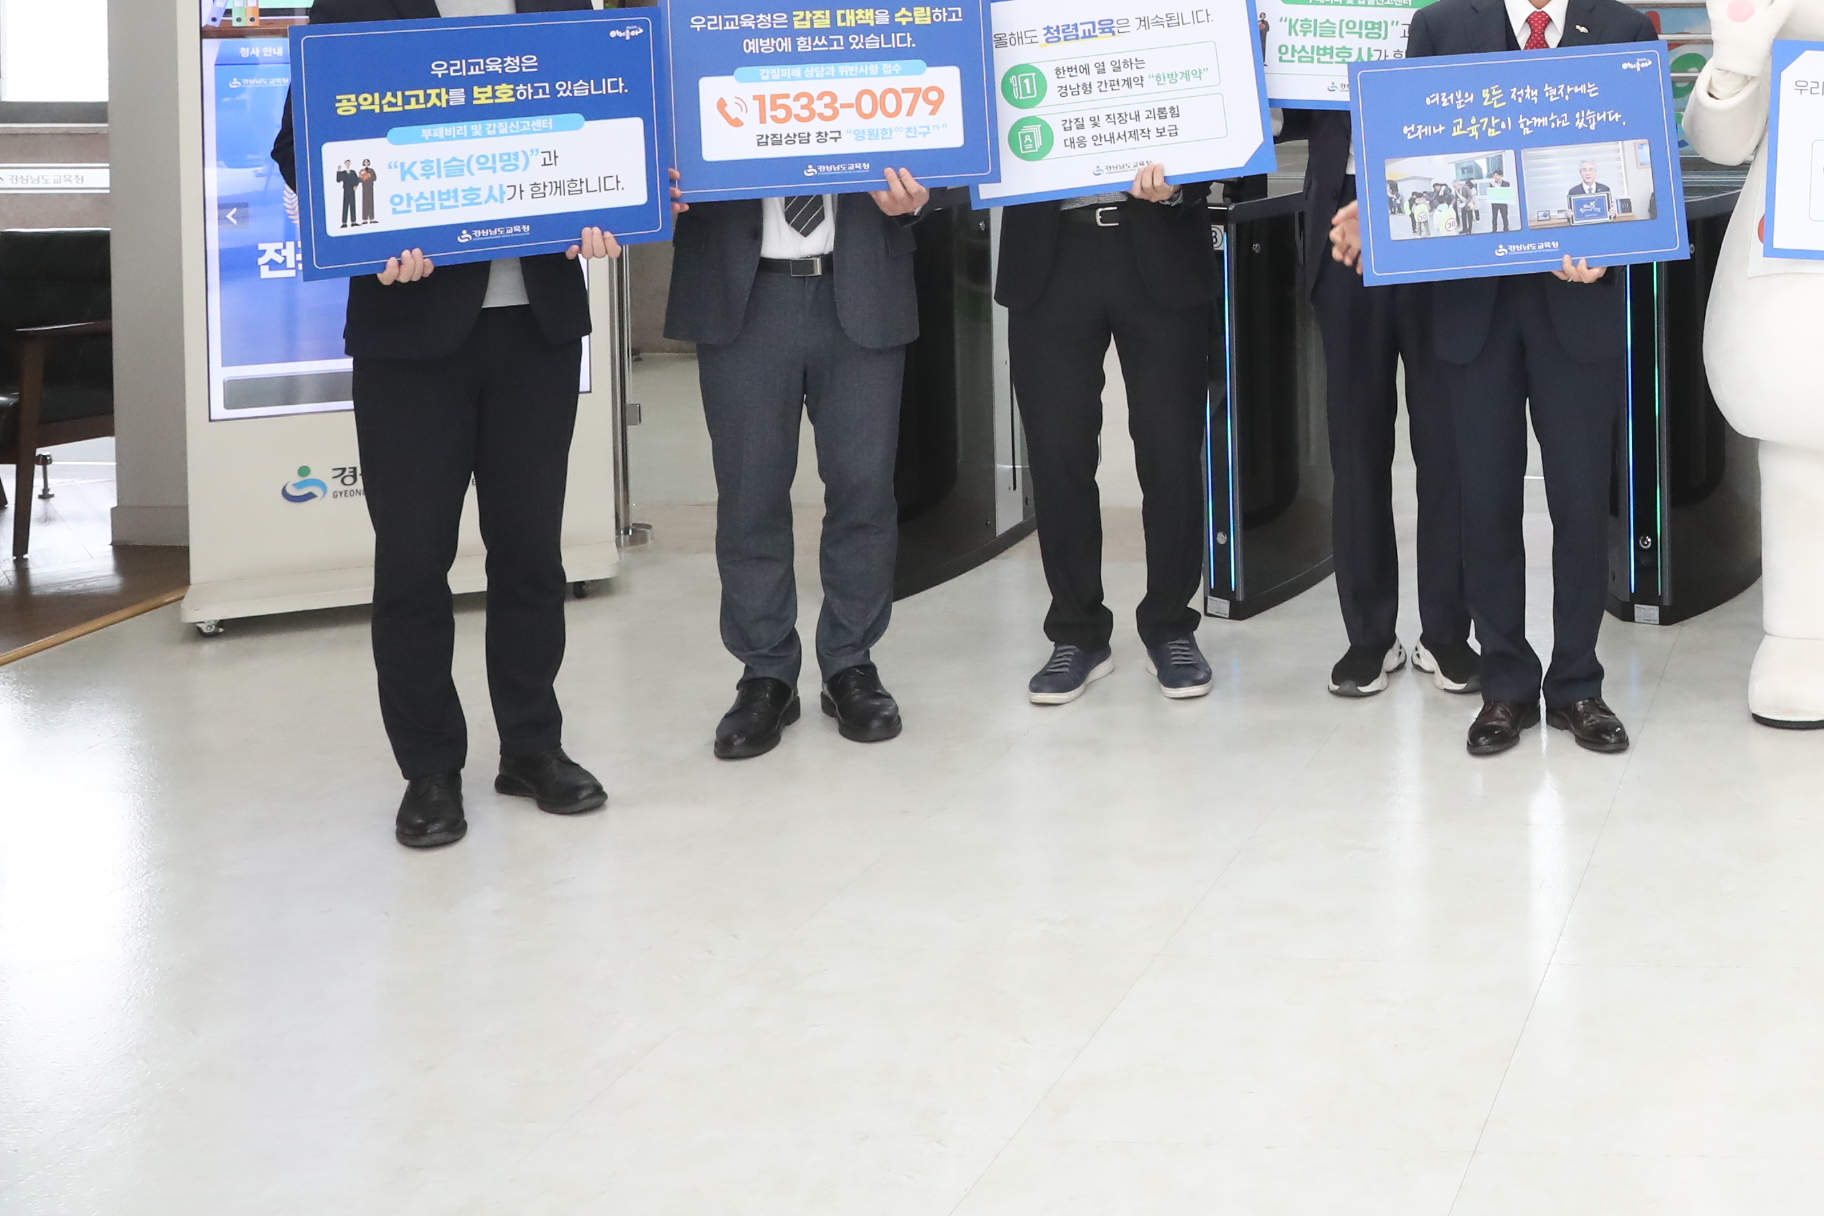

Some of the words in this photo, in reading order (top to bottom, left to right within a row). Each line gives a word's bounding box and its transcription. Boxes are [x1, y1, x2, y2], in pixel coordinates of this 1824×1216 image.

[690, 14, 788, 31] 우리교육청은
[792, 10, 831, 29] 갑질
[837, 9, 890, 27] 대책을
[894, 7, 963, 25] 수립하고
[993, 29, 1038, 49] 올해도
[1042, 18, 1130, 44] 청렴교육은
[1135, 8, 1214, 32] 계속됩니다.
[239, 47, 260, 57] 청사
[262, 47, 283, 57] 안내
[743, 37, 792, 54] 예방에
[796, 35, 844, 52] 힘쓰고
[849, 32, 916, 50] 있습니다.
[1278, 44, 1389, 64] 안심변호사가
[431, 55, 538, 78] 우리교육청은
[759, 66, 801, 80] 갑질피해
[804, 65, 835, 78] 상담과
[838, 62, 880, 76] 위반사항
[882, 61, 902, 74] 접수
[1054, 62, 1090, 80] 한번에
[1094, 61, 1106, 74] 열
[1110, 58, 1146, 72] 일하는
[335, 88, 466, 116] 공익신고자를
[472, 82, 550, 105] 보호하고
[555, 77, 628, 98] 있습니다.
[1056, 82, 1093, 98] 경남형
[1097, 75, 1144, 92] 간편계약
[1426, 92, 1473, 109] 여러분의
[1482, 85, 1506, 108] 모든
[1510, 87, 1539, 103] 정책
[1543, 82, 1599, 100] 현장에는
[753, 86, 944, 125] 1533-0079
[421, 124, 467, 140] 부패비리
[471, 123, 482, 136] 및
[485, 118, 553, 135] 갑질신고센터
[1061, 116, 1086, 132] 갑질
[1090, 114, 1101, 128] 및
[1104, 110, 1140, 126] 직장내
[1144, 105, 1180, 120] 괴롭힘
[1402, 122, 1445, 140] 언제나
[1451, 116, 1512, 140] 교육감이
[1518, 113, 1571, 136] 함께하고
[1575, 111, 1627, 129] 있습니다.
[756, 131, 811, 147] 갑질상담
[815, 130, 842, 144] 창구
[1064, 136, 1088, 150] 대응
[1092, 127, 1150, 146] 안내서제작
[1155, 124, 1179, 138] 보급
[390, 183, 524, 216] 안심변호사가
[529, 174, 624, 200] 함께합니다.
[472, 225, 530, 238] 경상남도교육청
